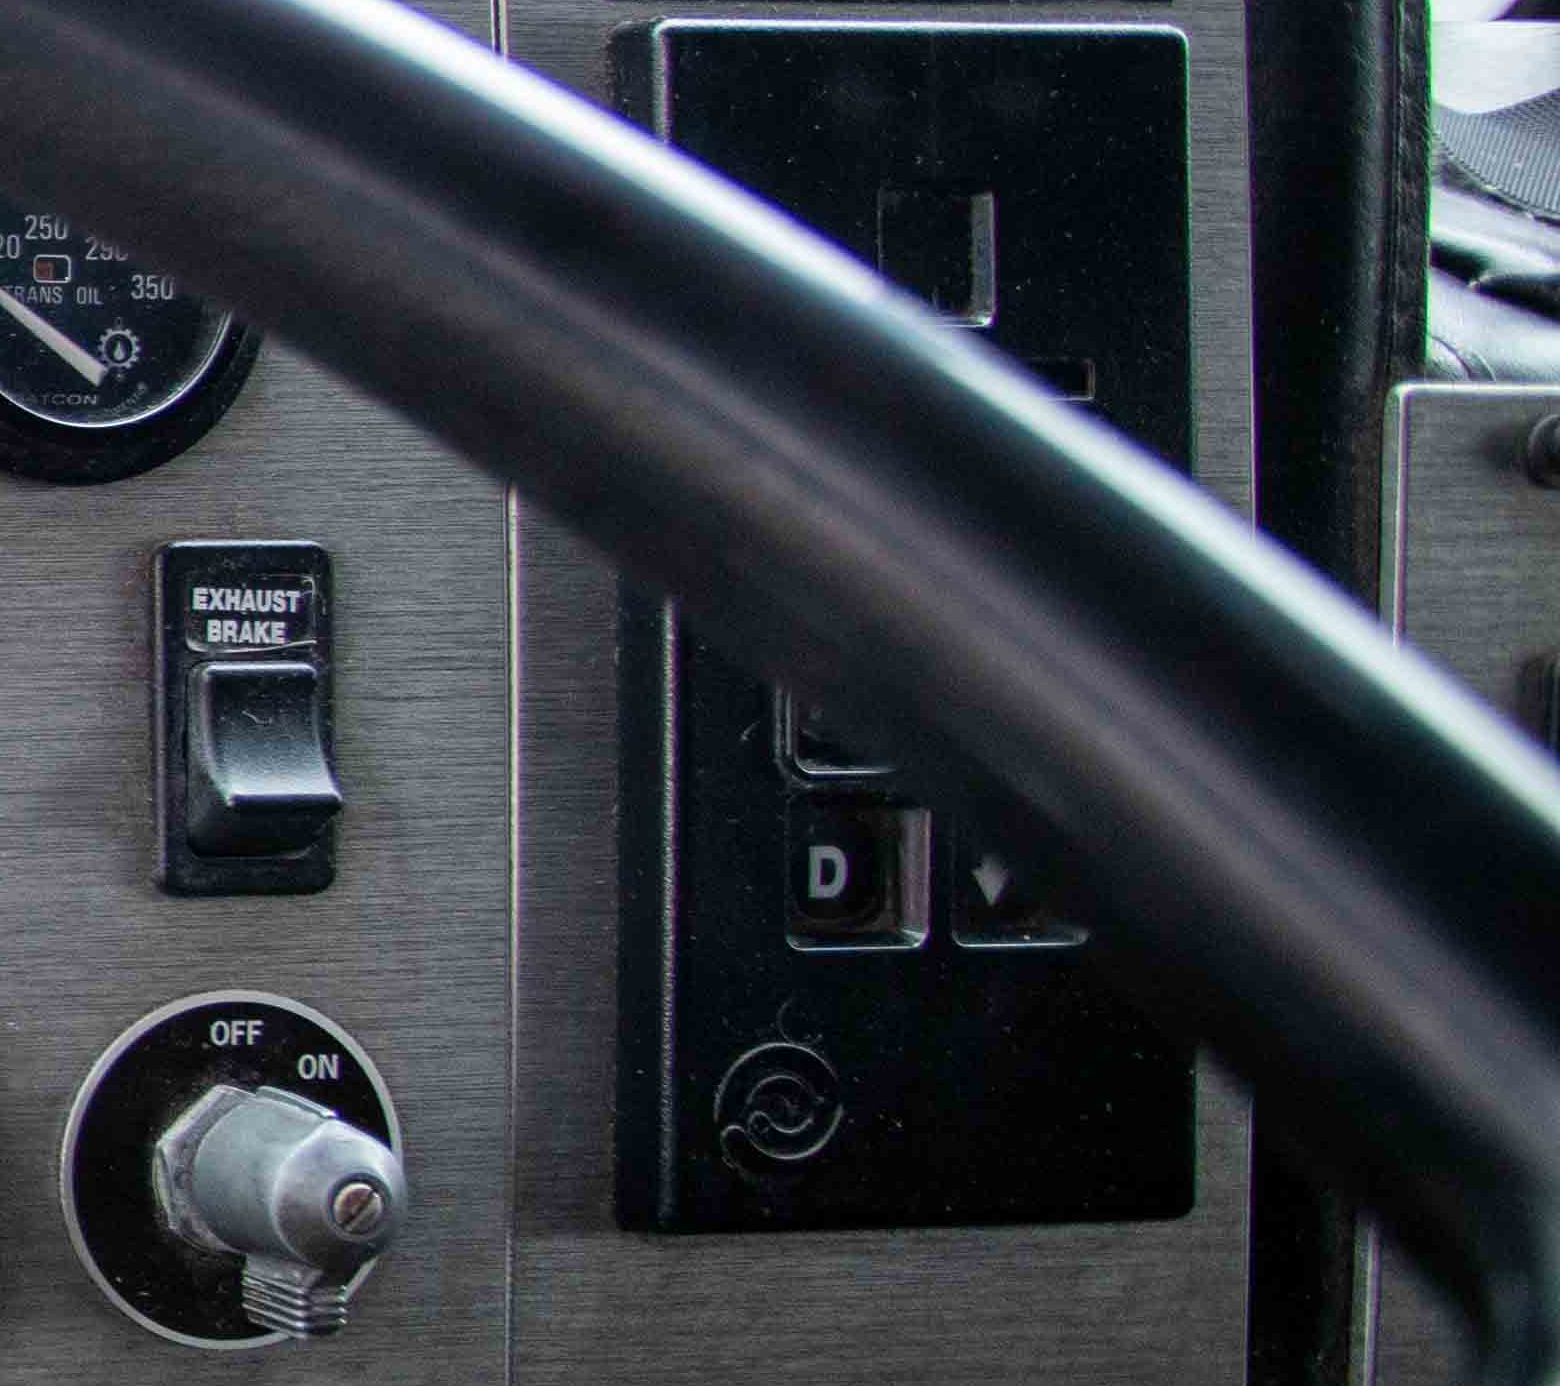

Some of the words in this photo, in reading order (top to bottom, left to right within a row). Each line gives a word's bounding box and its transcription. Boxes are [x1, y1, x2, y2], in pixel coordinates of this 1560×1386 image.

[25, 214, 68, 240] 250
[76, 287, 103, 305] OIL
[130, 273, 175, 300] 350
[192, 587, 301, 614] EXHAUST
[207, 619, 286, 644] BRAKE
[808, 845, 848, 899] D
[210, 1020, 263, 1047] OFF
[296, 1054, 340, 1081] ON
